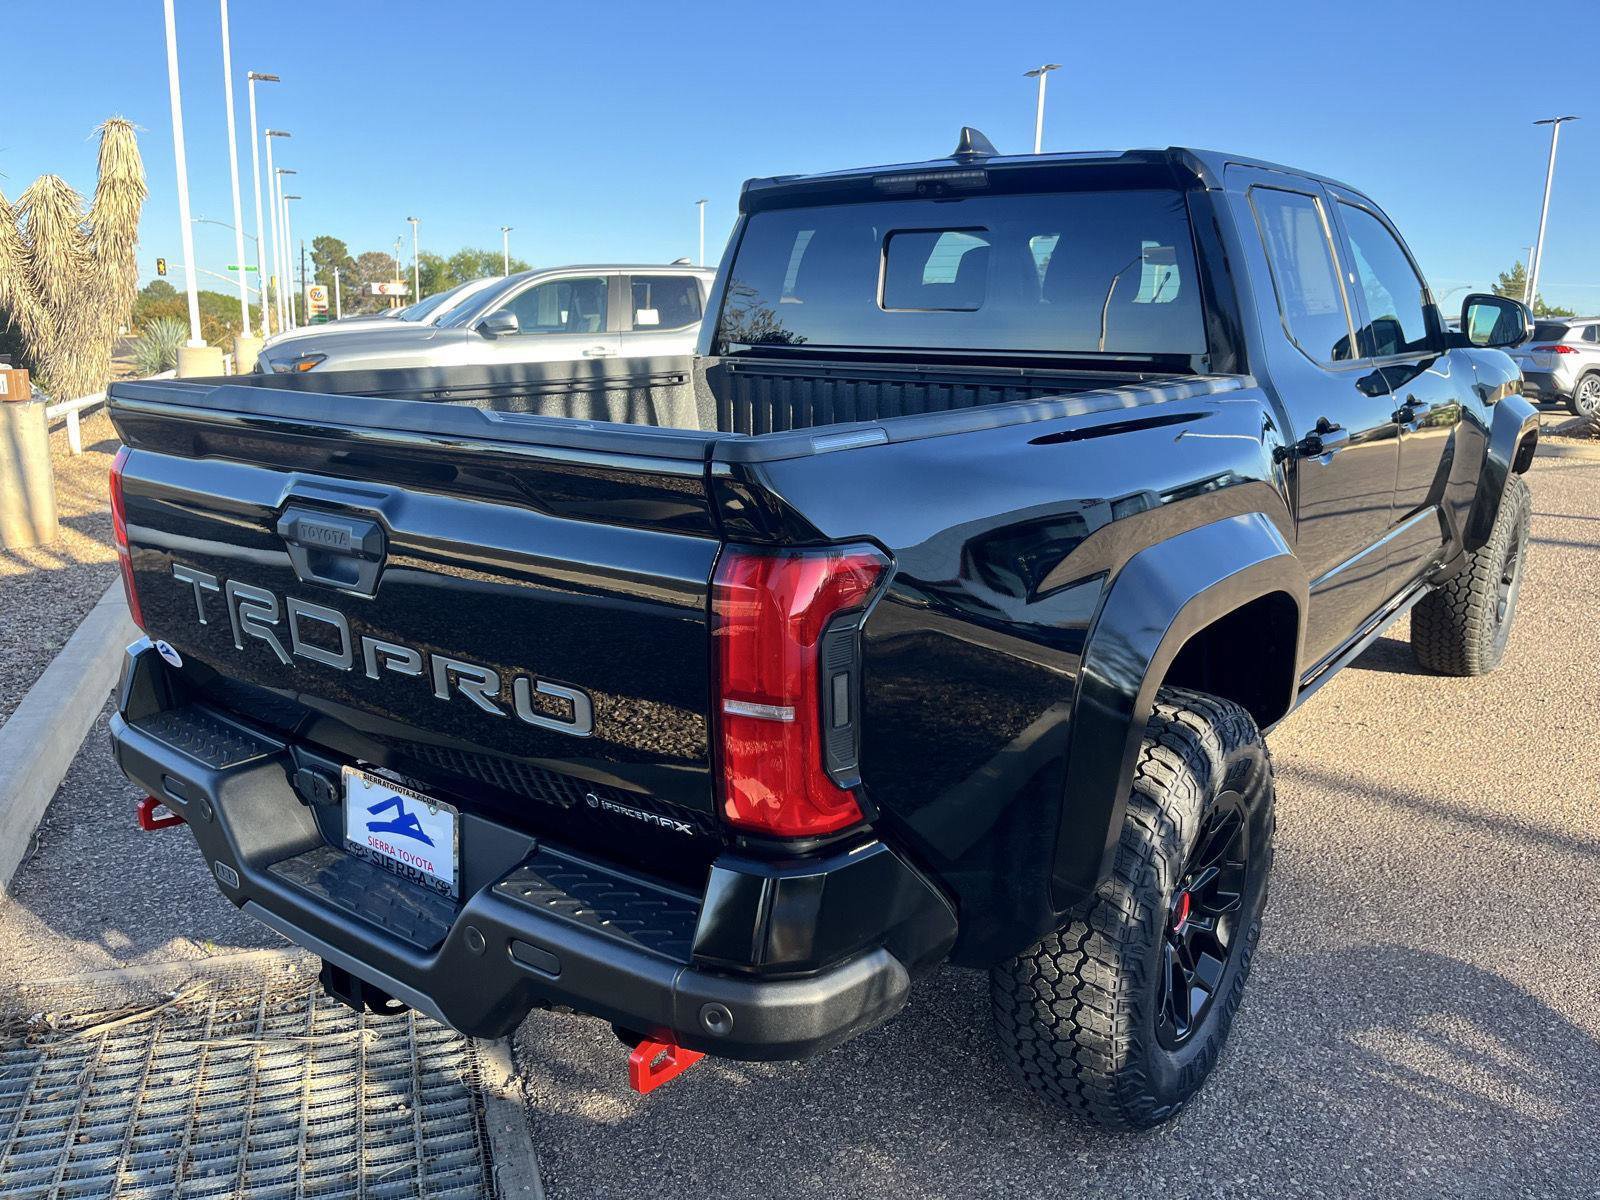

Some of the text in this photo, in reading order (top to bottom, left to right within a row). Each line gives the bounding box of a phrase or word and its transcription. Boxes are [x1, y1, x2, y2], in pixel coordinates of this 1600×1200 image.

[300, 524, 348, 546] TOYOTA
[171, 562, 595, 738] TRD PRO
[367, 835, 435, 873] SIERRA TOYOTA
[371, 850, 427, 887] SIERRA
